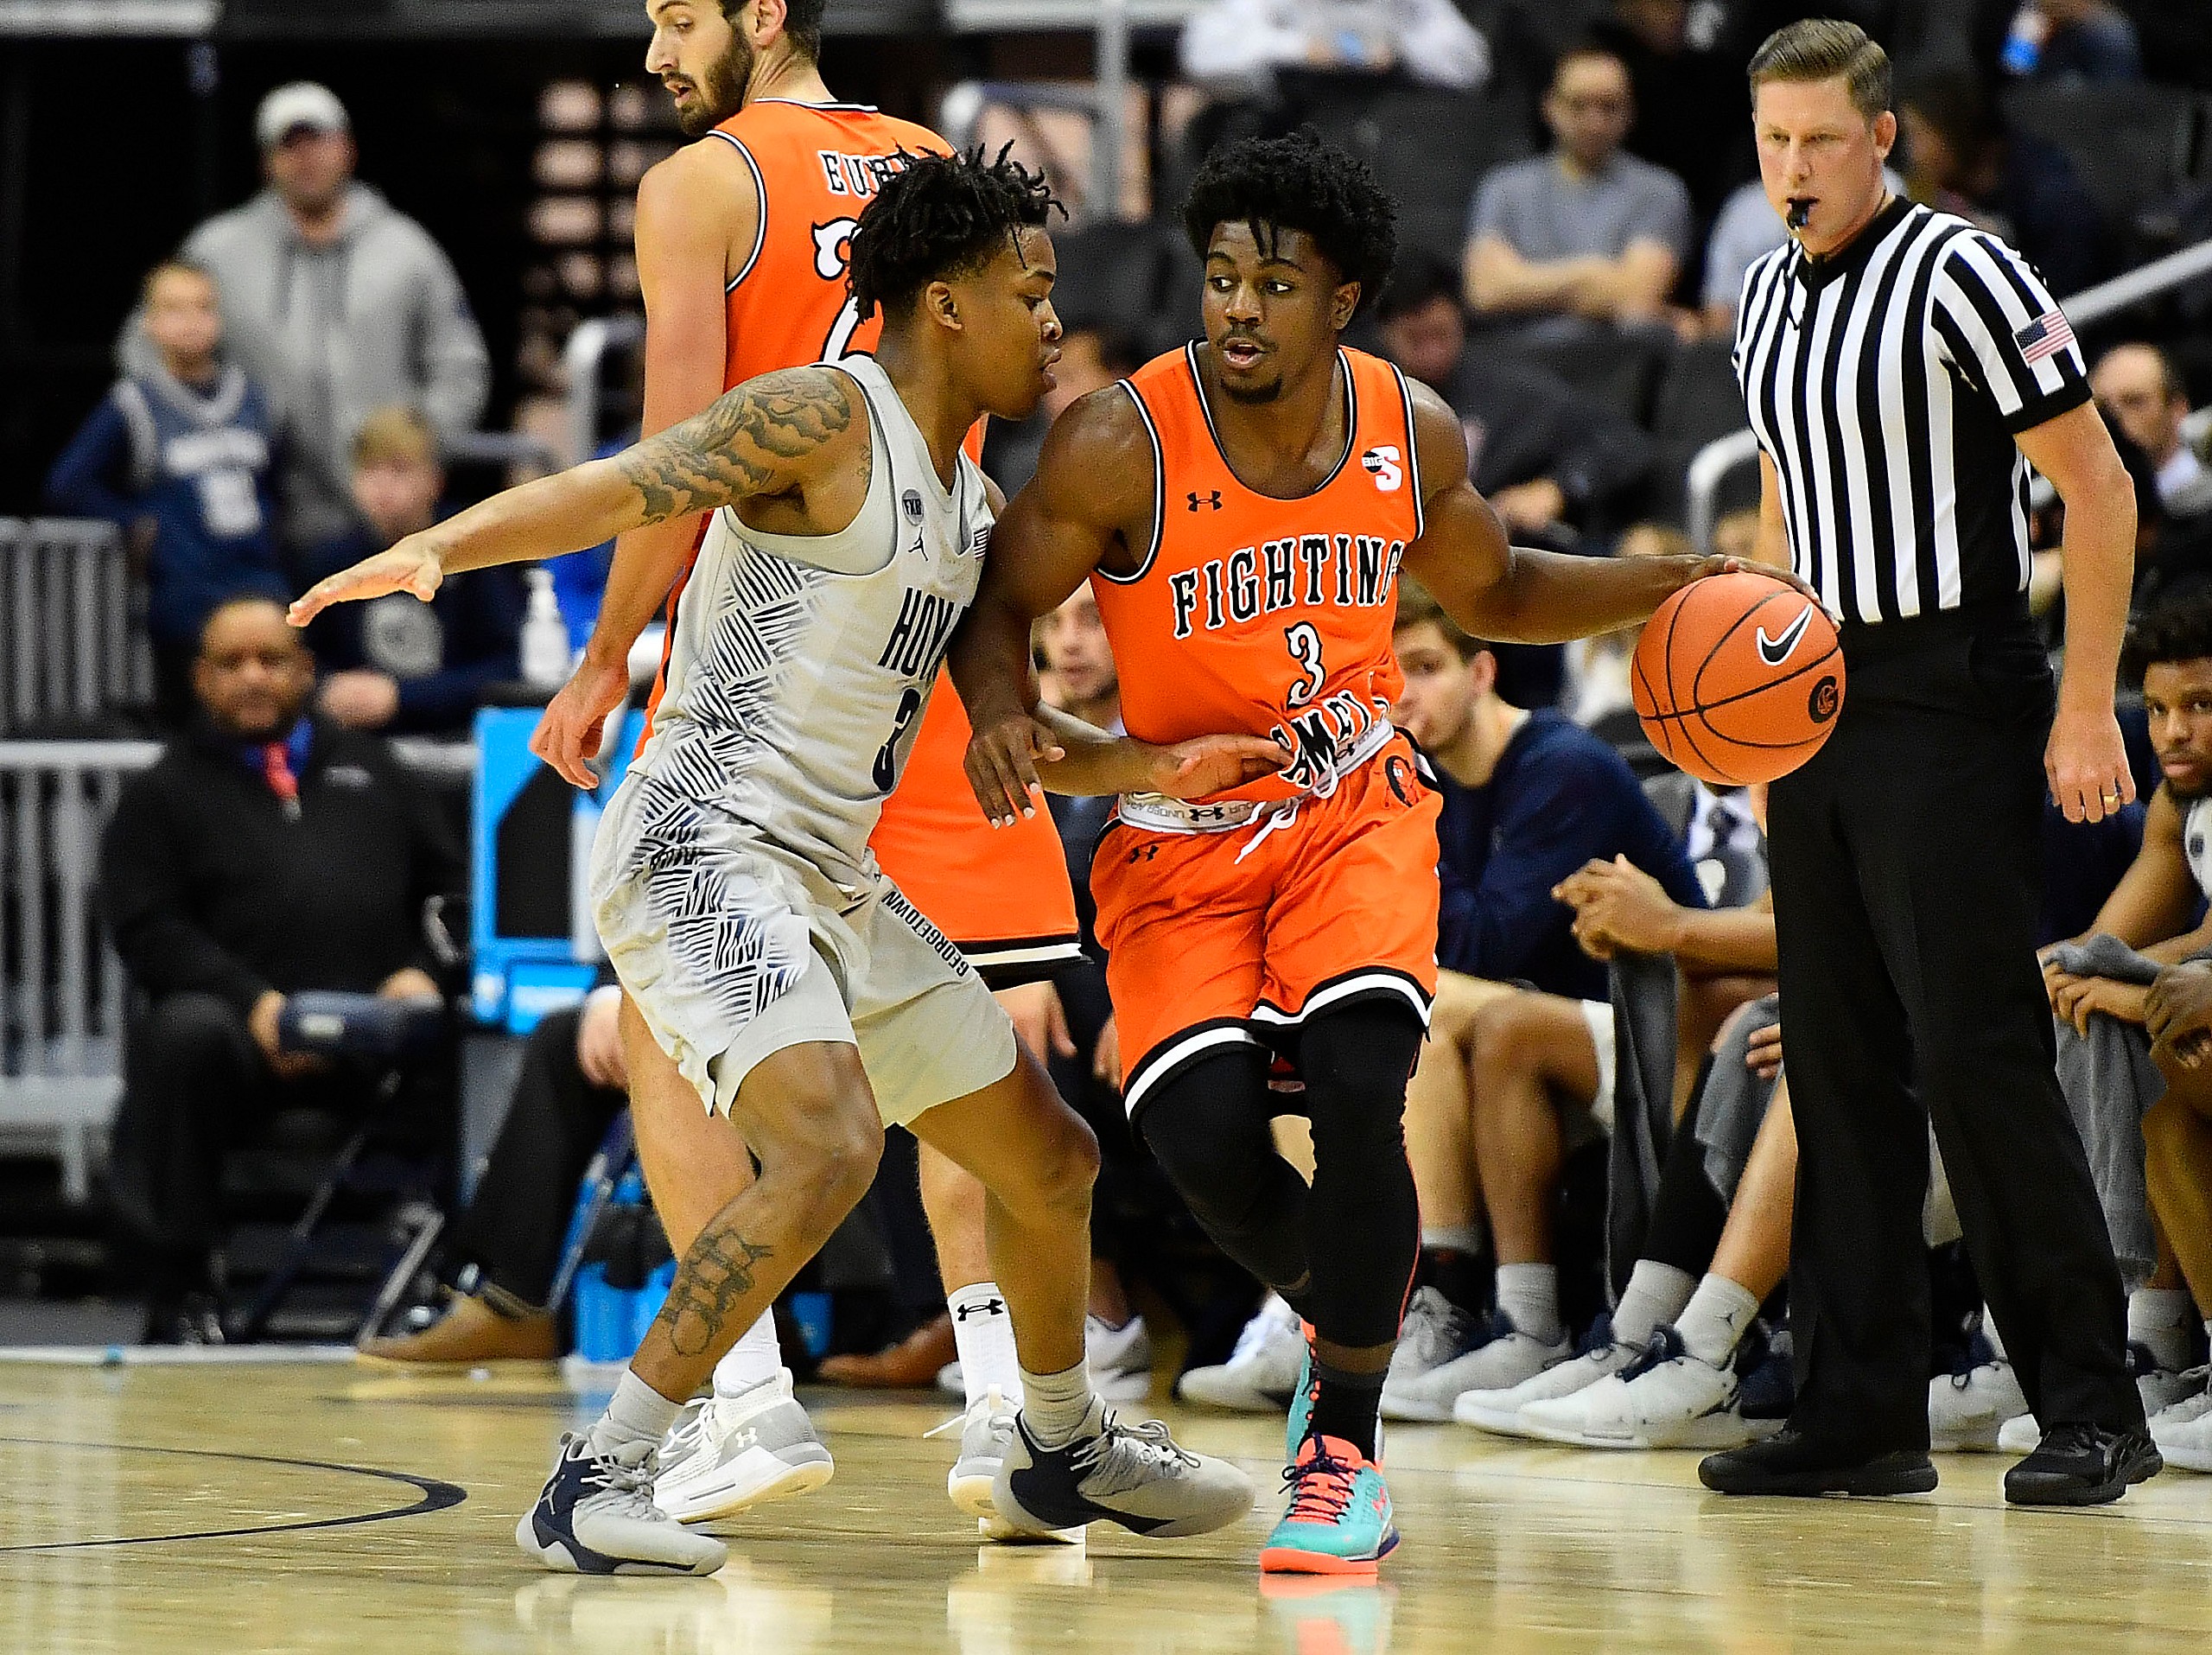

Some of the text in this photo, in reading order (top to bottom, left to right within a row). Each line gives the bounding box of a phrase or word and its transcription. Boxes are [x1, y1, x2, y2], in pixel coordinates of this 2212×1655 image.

[1284, 621, 1326, 709] 3
[872, 688, 922, 792] 3
[881, 890, 969, 977] GEORGETOWN
